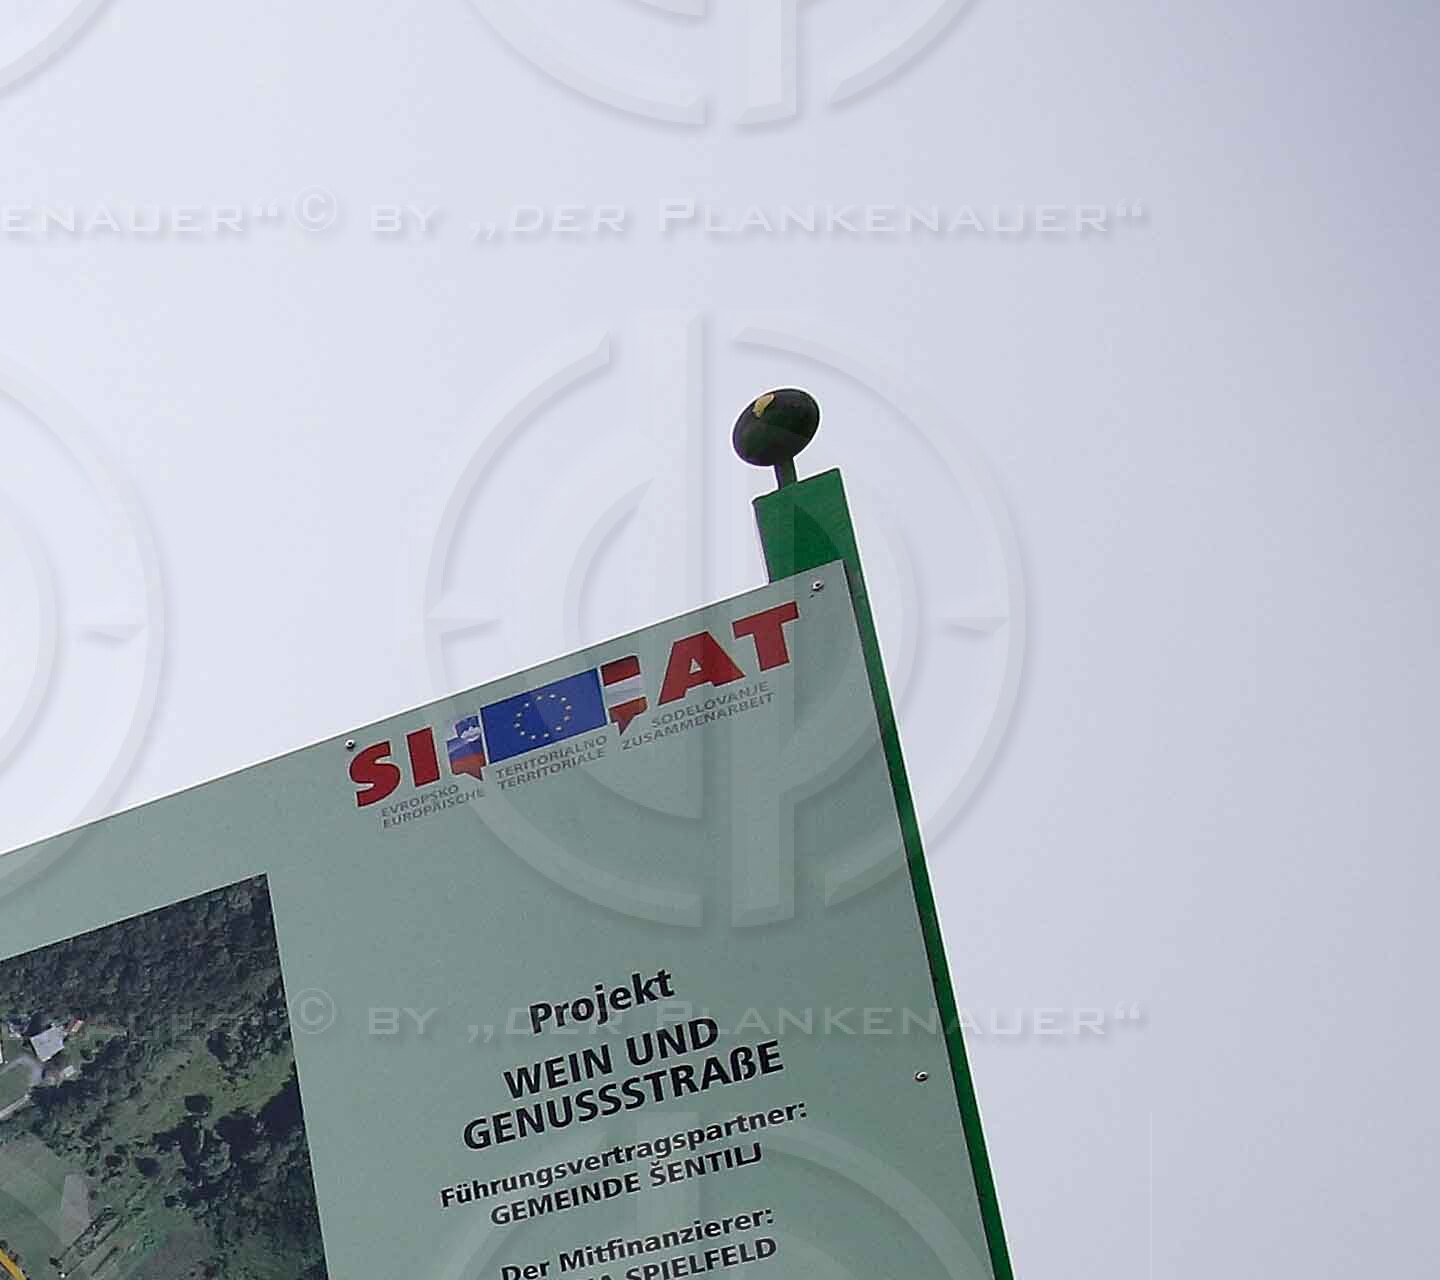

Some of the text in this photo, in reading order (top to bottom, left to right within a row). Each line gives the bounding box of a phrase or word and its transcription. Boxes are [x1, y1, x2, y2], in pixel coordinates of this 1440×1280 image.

[530, 969, 675, 1034] Projekt
[504, 1019, 718, 1098] WEIN UND
[441, 1103, 807, 1207] Führungsvertragspartner:
[491, 1143, 761, 1224] GEMEINDE ŠENTILJ
[560, 1209, 773, 1272] Mitfinanzierer:
